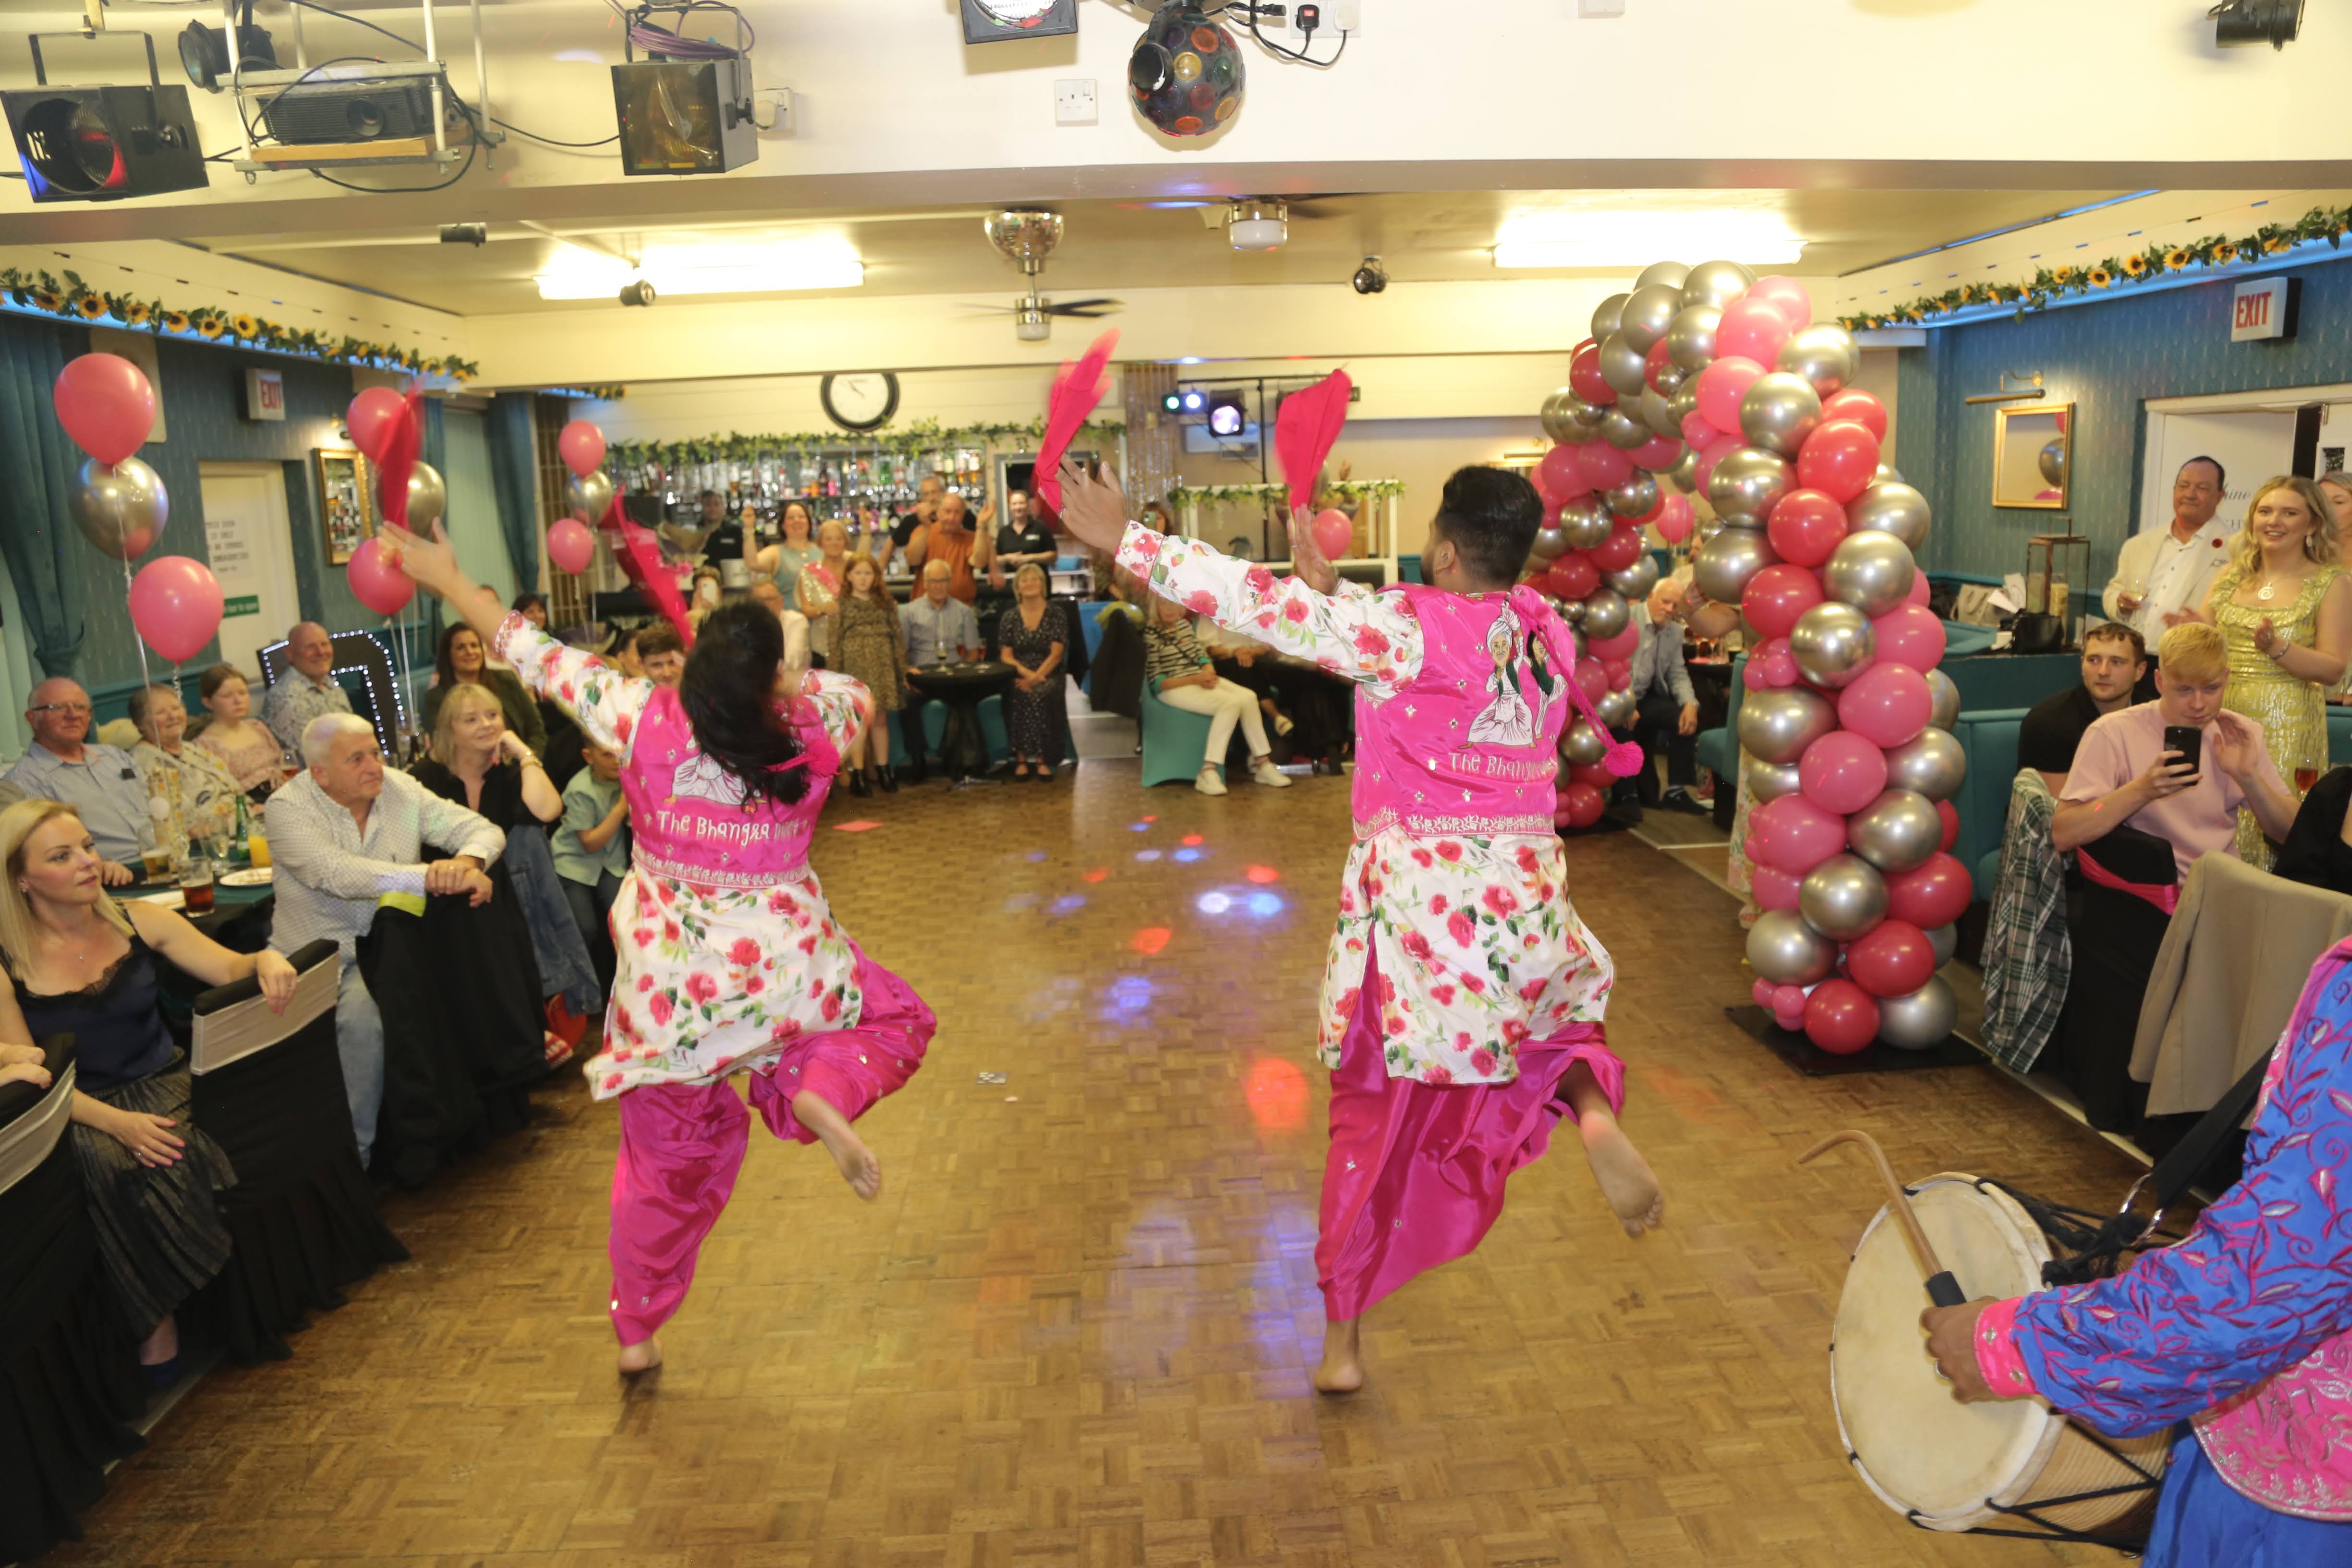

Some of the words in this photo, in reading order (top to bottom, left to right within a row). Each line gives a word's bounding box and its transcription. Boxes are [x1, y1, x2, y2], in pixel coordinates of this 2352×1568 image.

[2236, 291, 2272, 329] EXIT
[261, 378, 282, 410] EXIT
[1448, 753, 1481, 771] The
[656, 810, 691, 834] The
[697, 816, 770, 846] Bhangra
